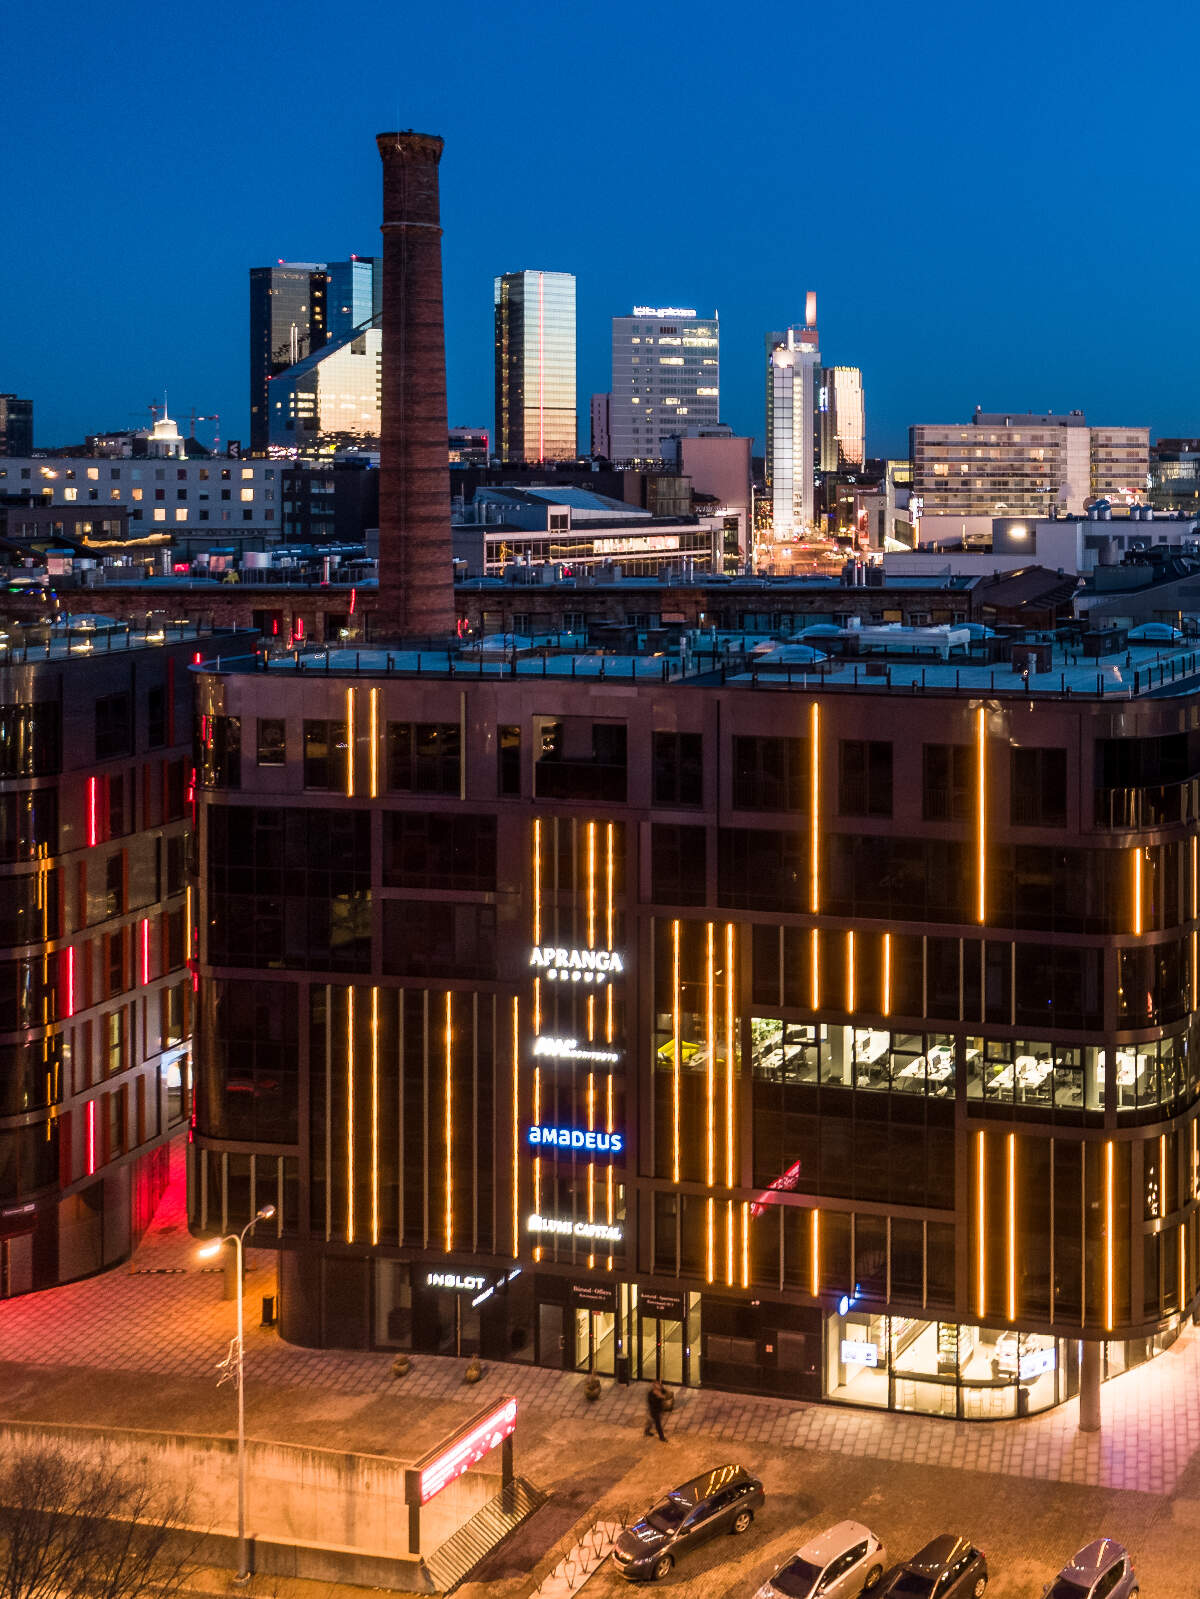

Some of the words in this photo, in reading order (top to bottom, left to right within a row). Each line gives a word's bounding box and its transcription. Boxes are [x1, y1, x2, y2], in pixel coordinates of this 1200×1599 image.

[529, 946, 624, 971] APRANGA
[547, 968, 606, 983] GROUP
[574, 1222, 622, 1241] CAPITAL
[427, 1272, 486, 1290] INGLOT
